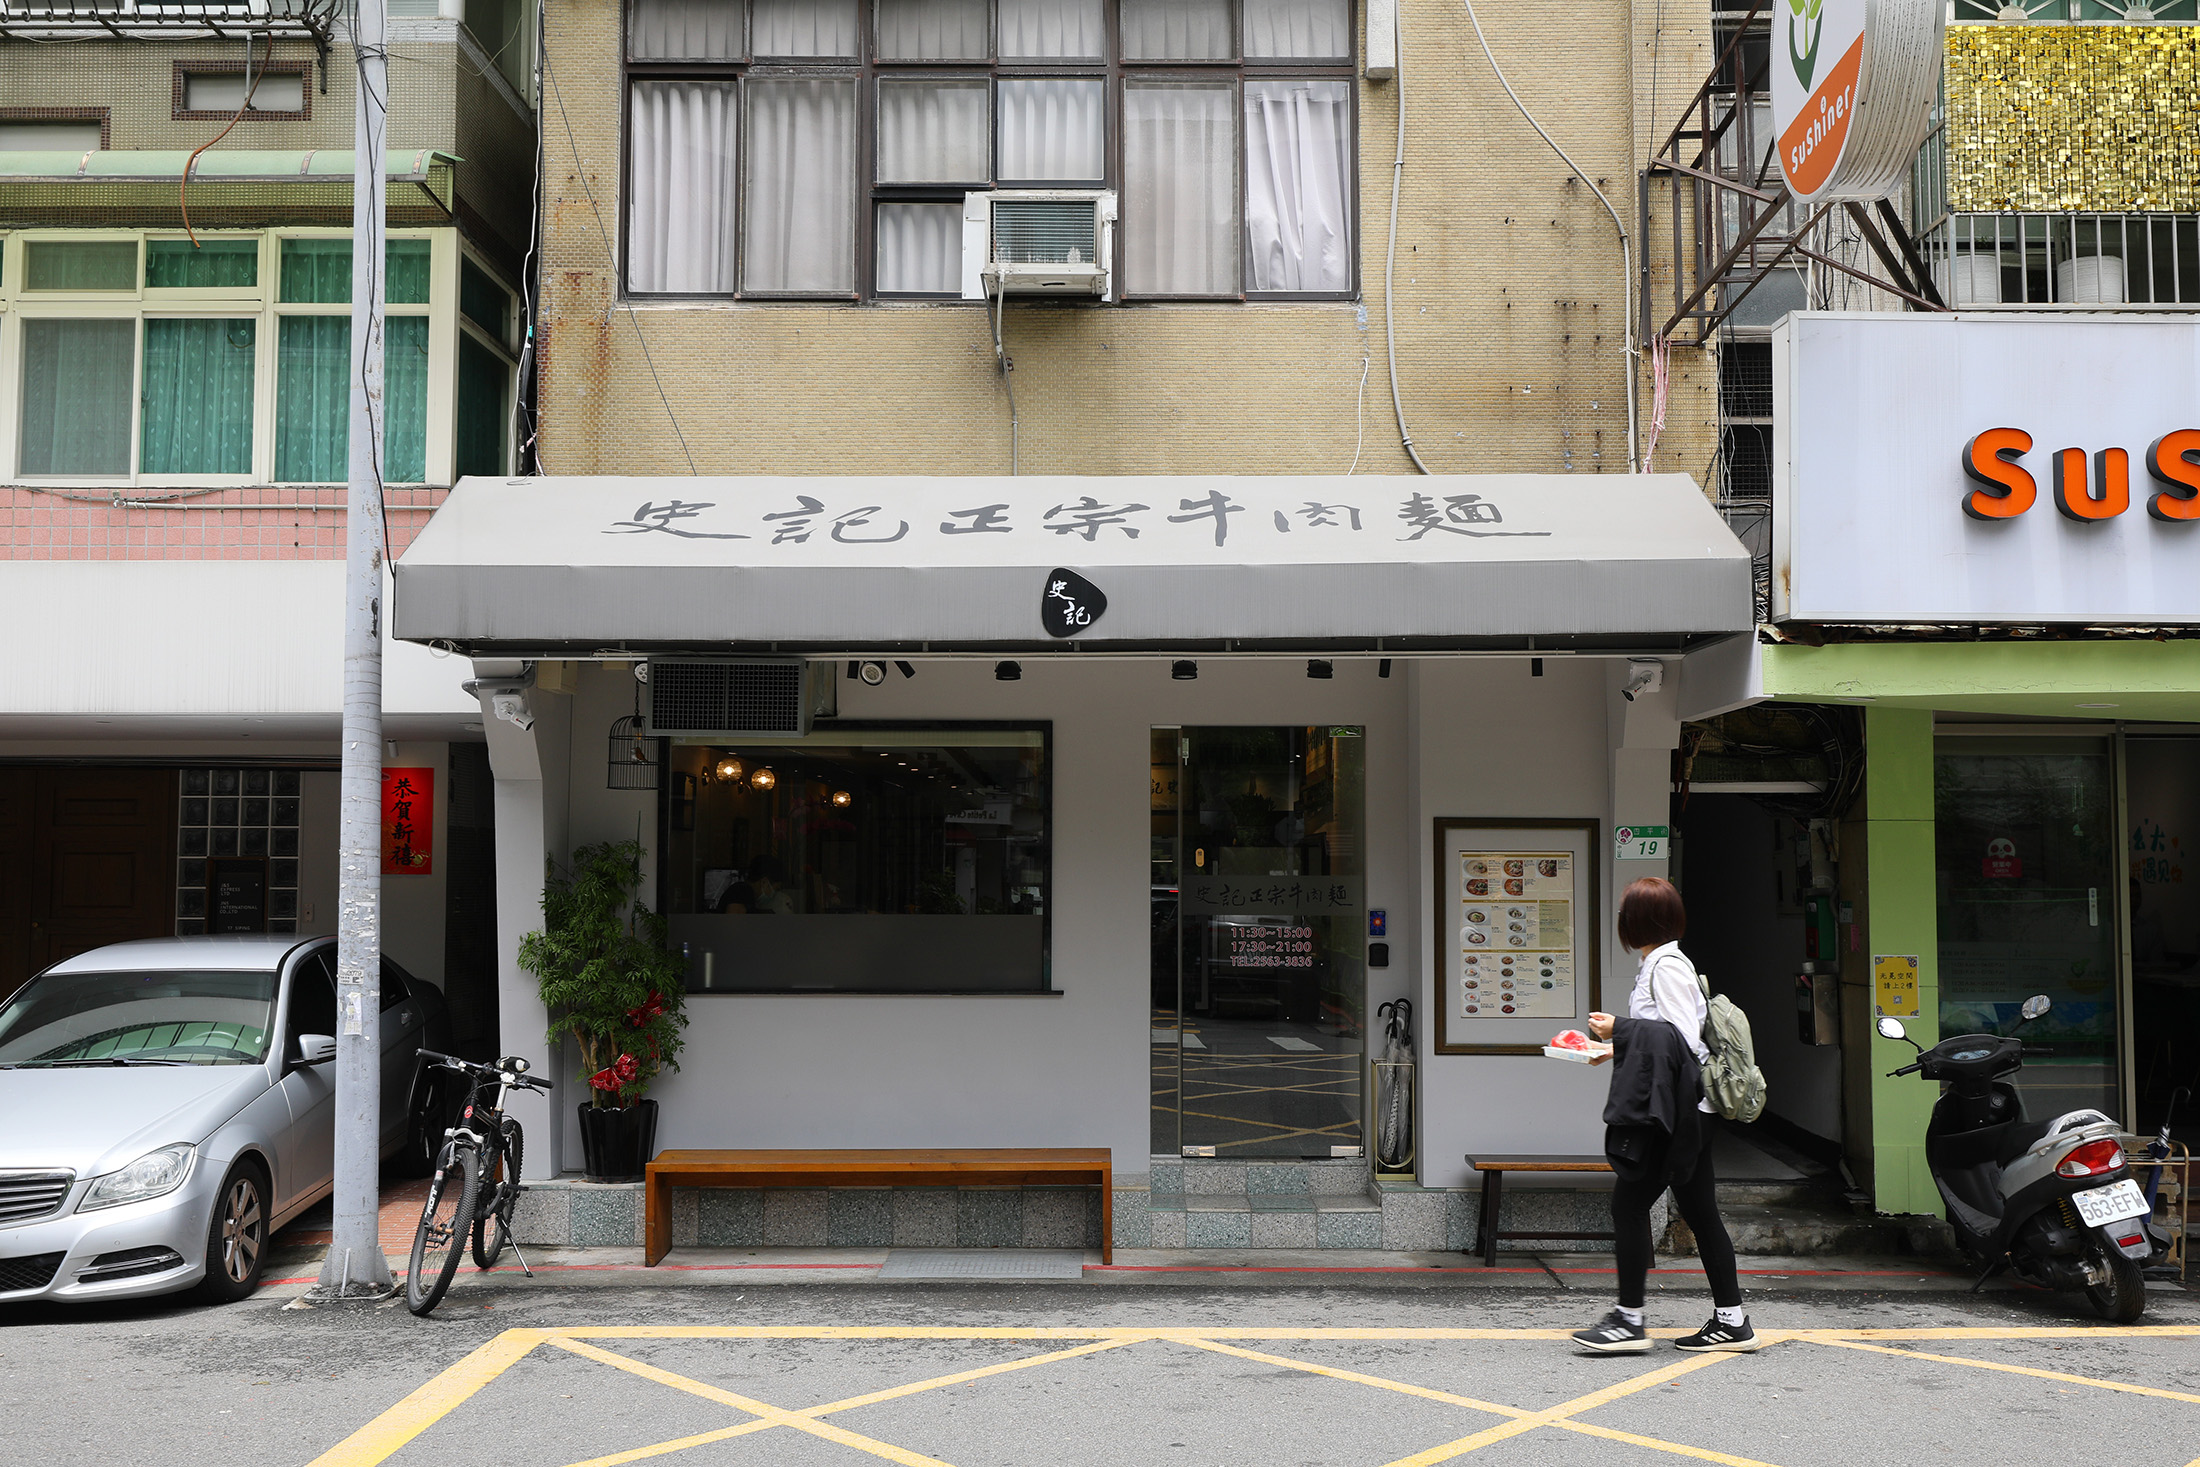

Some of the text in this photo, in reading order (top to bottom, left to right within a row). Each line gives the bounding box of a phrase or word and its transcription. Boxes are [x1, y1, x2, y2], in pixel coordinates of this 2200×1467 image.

[601, 490, 1552, 547] 史記正宗牛肉麵
[1048, 580, 1091, 625] 史記
[390, 778, 419, 866] 恭賀新禧
[1639, 841, 1658, 855] 19
[1194, 882, 1353, 908] 史記正宗牛肉麵
[1231, 927, 1312, 938] 11:30~15:00
[1231, 941, 1312, 952] 17:30~21:00
[1230, 955, 1313, 967] TEL:2563-3836
